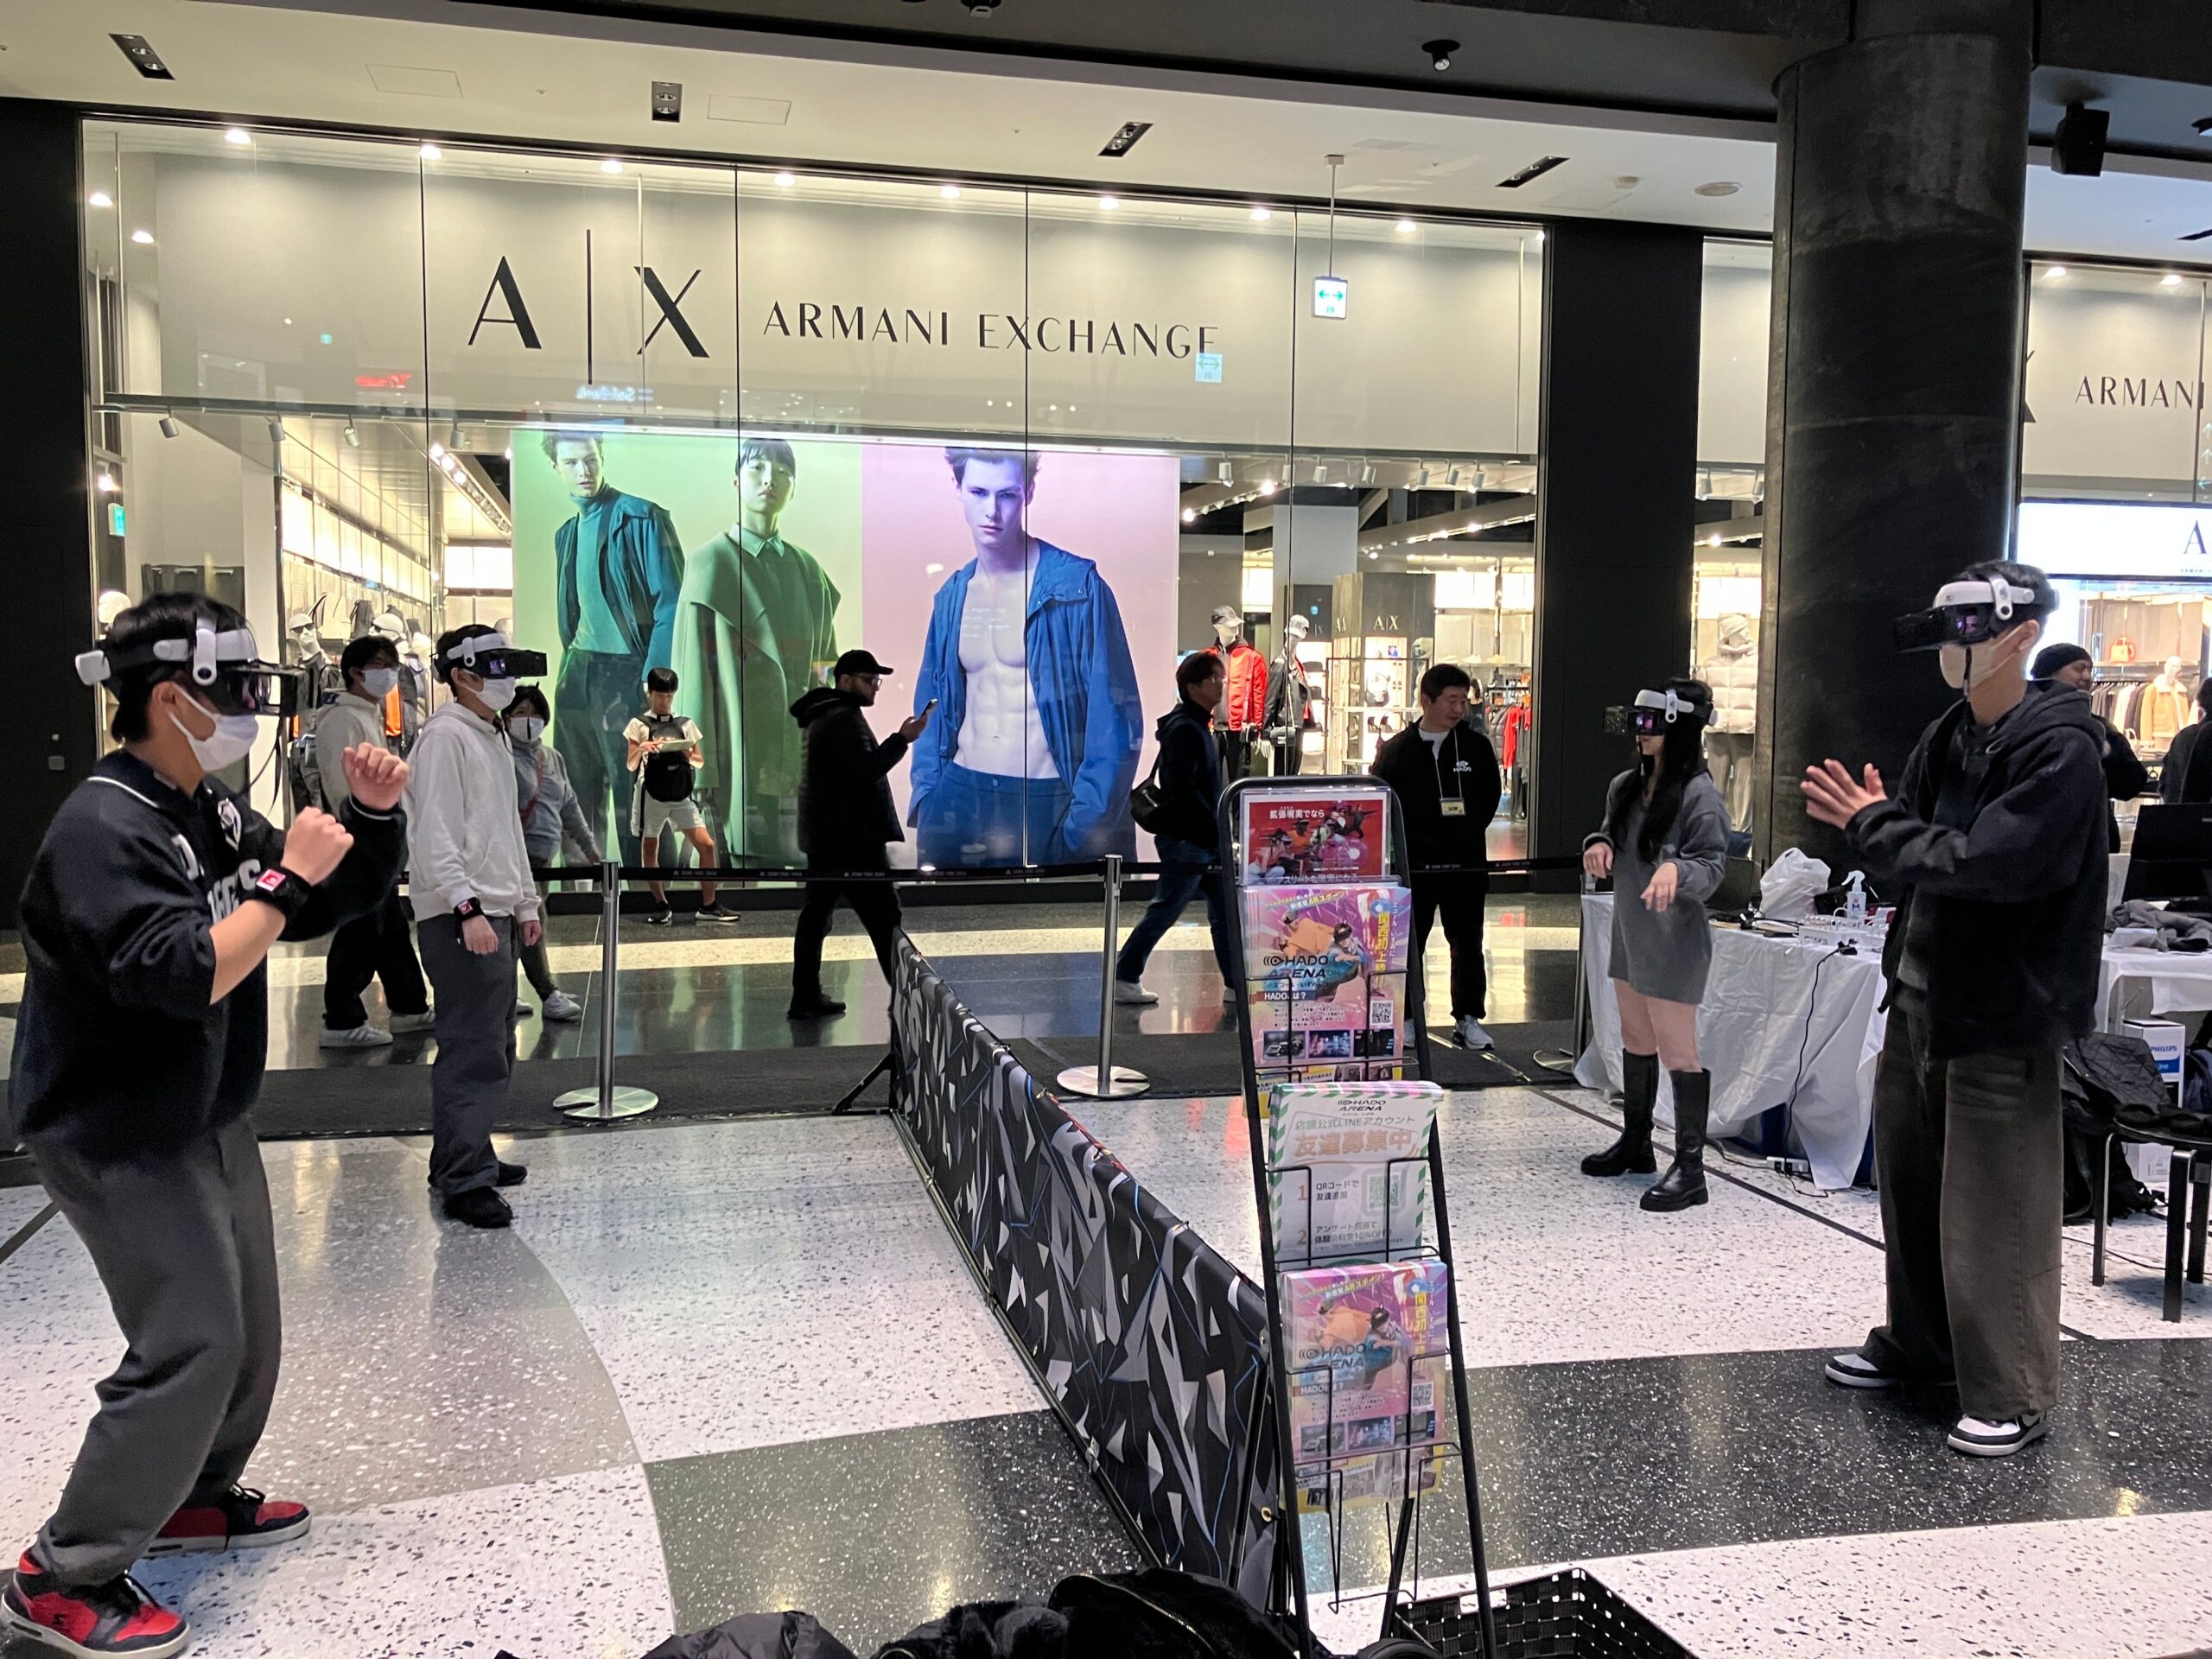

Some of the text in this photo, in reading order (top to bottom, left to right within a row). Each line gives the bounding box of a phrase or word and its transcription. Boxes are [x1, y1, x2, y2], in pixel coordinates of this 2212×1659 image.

[764, 301, 1218, 359] ARMANI EXCHANGE
[1286, 955, 1329, 966] HADO
[1294, 1129, 1412, 1157] 友達募集中
[1316, 1179, 1359, 1191] QRコードで
[1298, 1185, 1307, 1201] 1
[1297, 1230, 1307, 1245] 2
